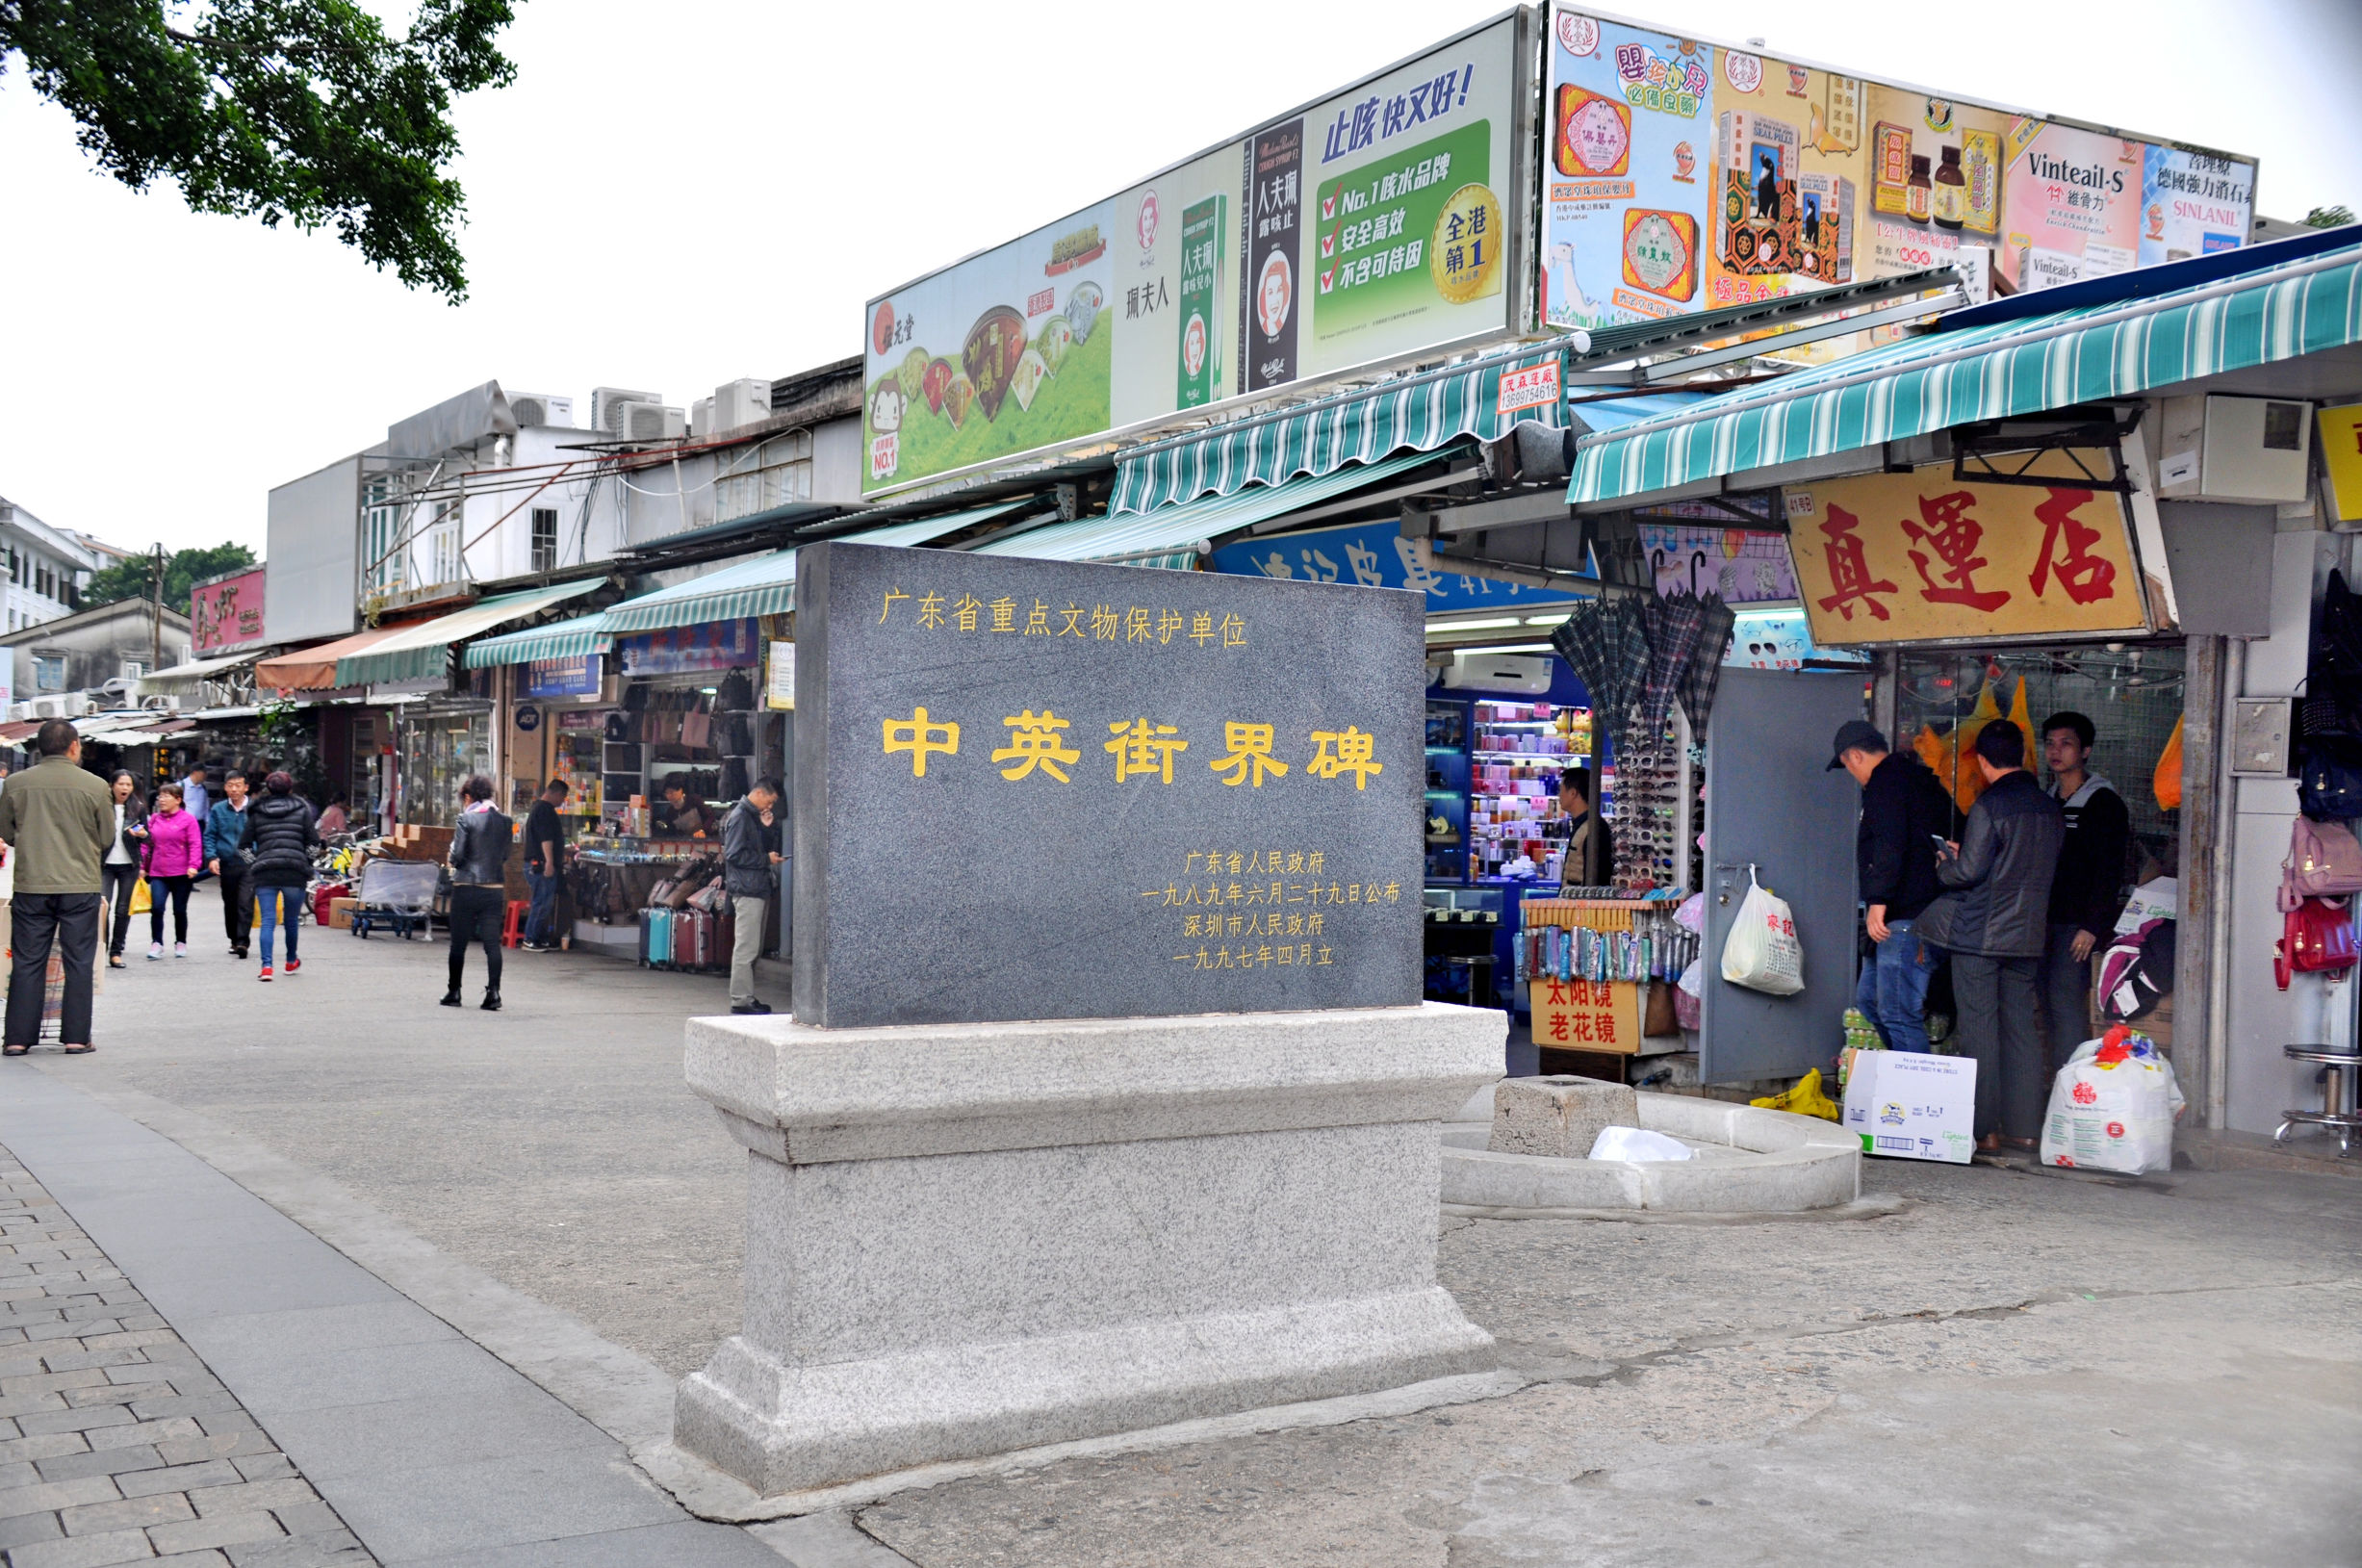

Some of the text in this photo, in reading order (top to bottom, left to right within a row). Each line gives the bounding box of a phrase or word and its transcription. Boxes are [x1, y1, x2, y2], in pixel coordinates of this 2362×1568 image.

[1618, 44, 1708, 97] 嬰孩小兒
[1627, 85, 1697, 116] 必備良藥
[1753, 127, 1794, 145] SEAL PILLS
[1274, 149, 1293, 167] SYRUP
[2029, 151, 2124, 193] Vinteail-S
[2067, 189, 2106, 213] 維骨力
[2173, 199, 2239, 228] SINLANIL
[1341, 206, 1406, 254] 安全高效
[1445, 205, 1487, 245] 全港
[1339, 238, 1424, 290] 不含可待因
[1445, 237, 1487, 277] 第1
[2033, 258, 2079, 280] Vinteail-S
[1502, 382, 1557, 409] 13699754616
[874, 449, 895, 471] NO.1
[1788, 498, 1813, 513] 41号B
[1817, 487, 2117, 622] 真運店
[878, 587, 1248, 650] 广东省重点文物保护单位
[520, 714, 537, 724] ADT
[882, 707, 1384, 791] 中英街界碑
[1183, 849, 1325, 877] 广东省人民政府
[1142, 879, 1401, 908] 一九八九年六月二十九日公布
[1183, 911, 1324, 938] 深圳市人民政府
[1172, 942, 1334, 970] 一九九七年四月立
[1547, 977, 1614, 1009] 太阳镜
[1549, 1012, 1616, 1043] 老花镜
